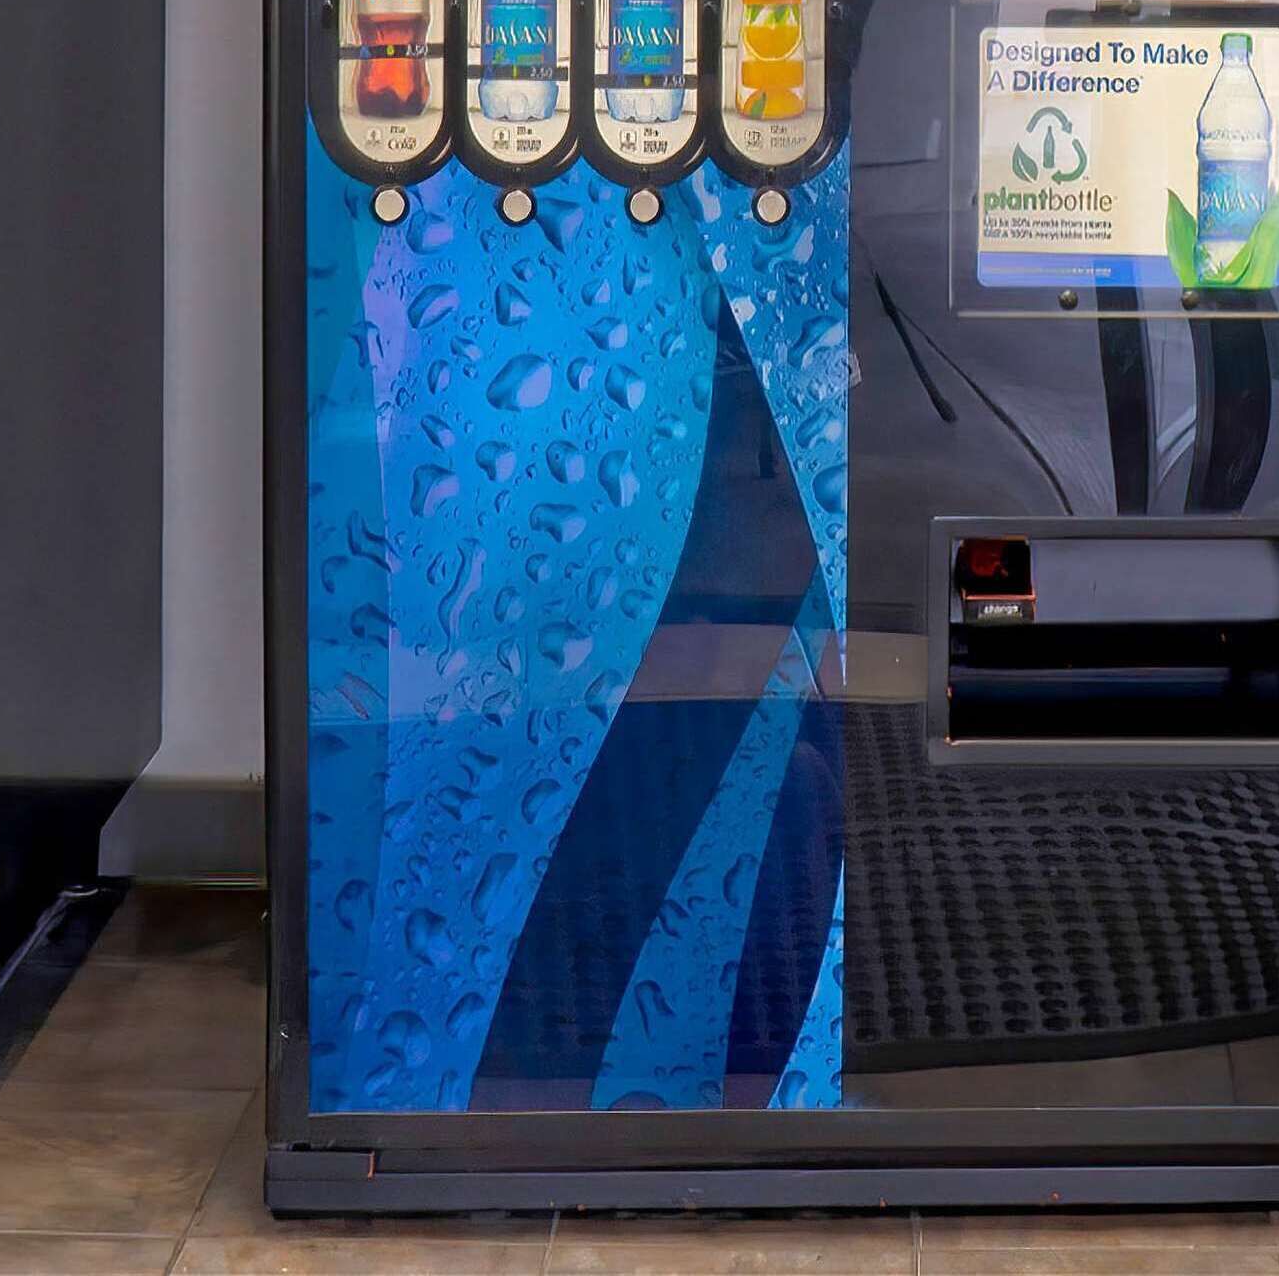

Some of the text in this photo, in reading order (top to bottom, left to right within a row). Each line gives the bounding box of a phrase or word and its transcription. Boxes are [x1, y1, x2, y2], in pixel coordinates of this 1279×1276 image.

[986, 40, 1209, 67] Designed To Make
[986, 71, 1141, 94] A Difference
[983, 187, 1114, 214] plantbottle
